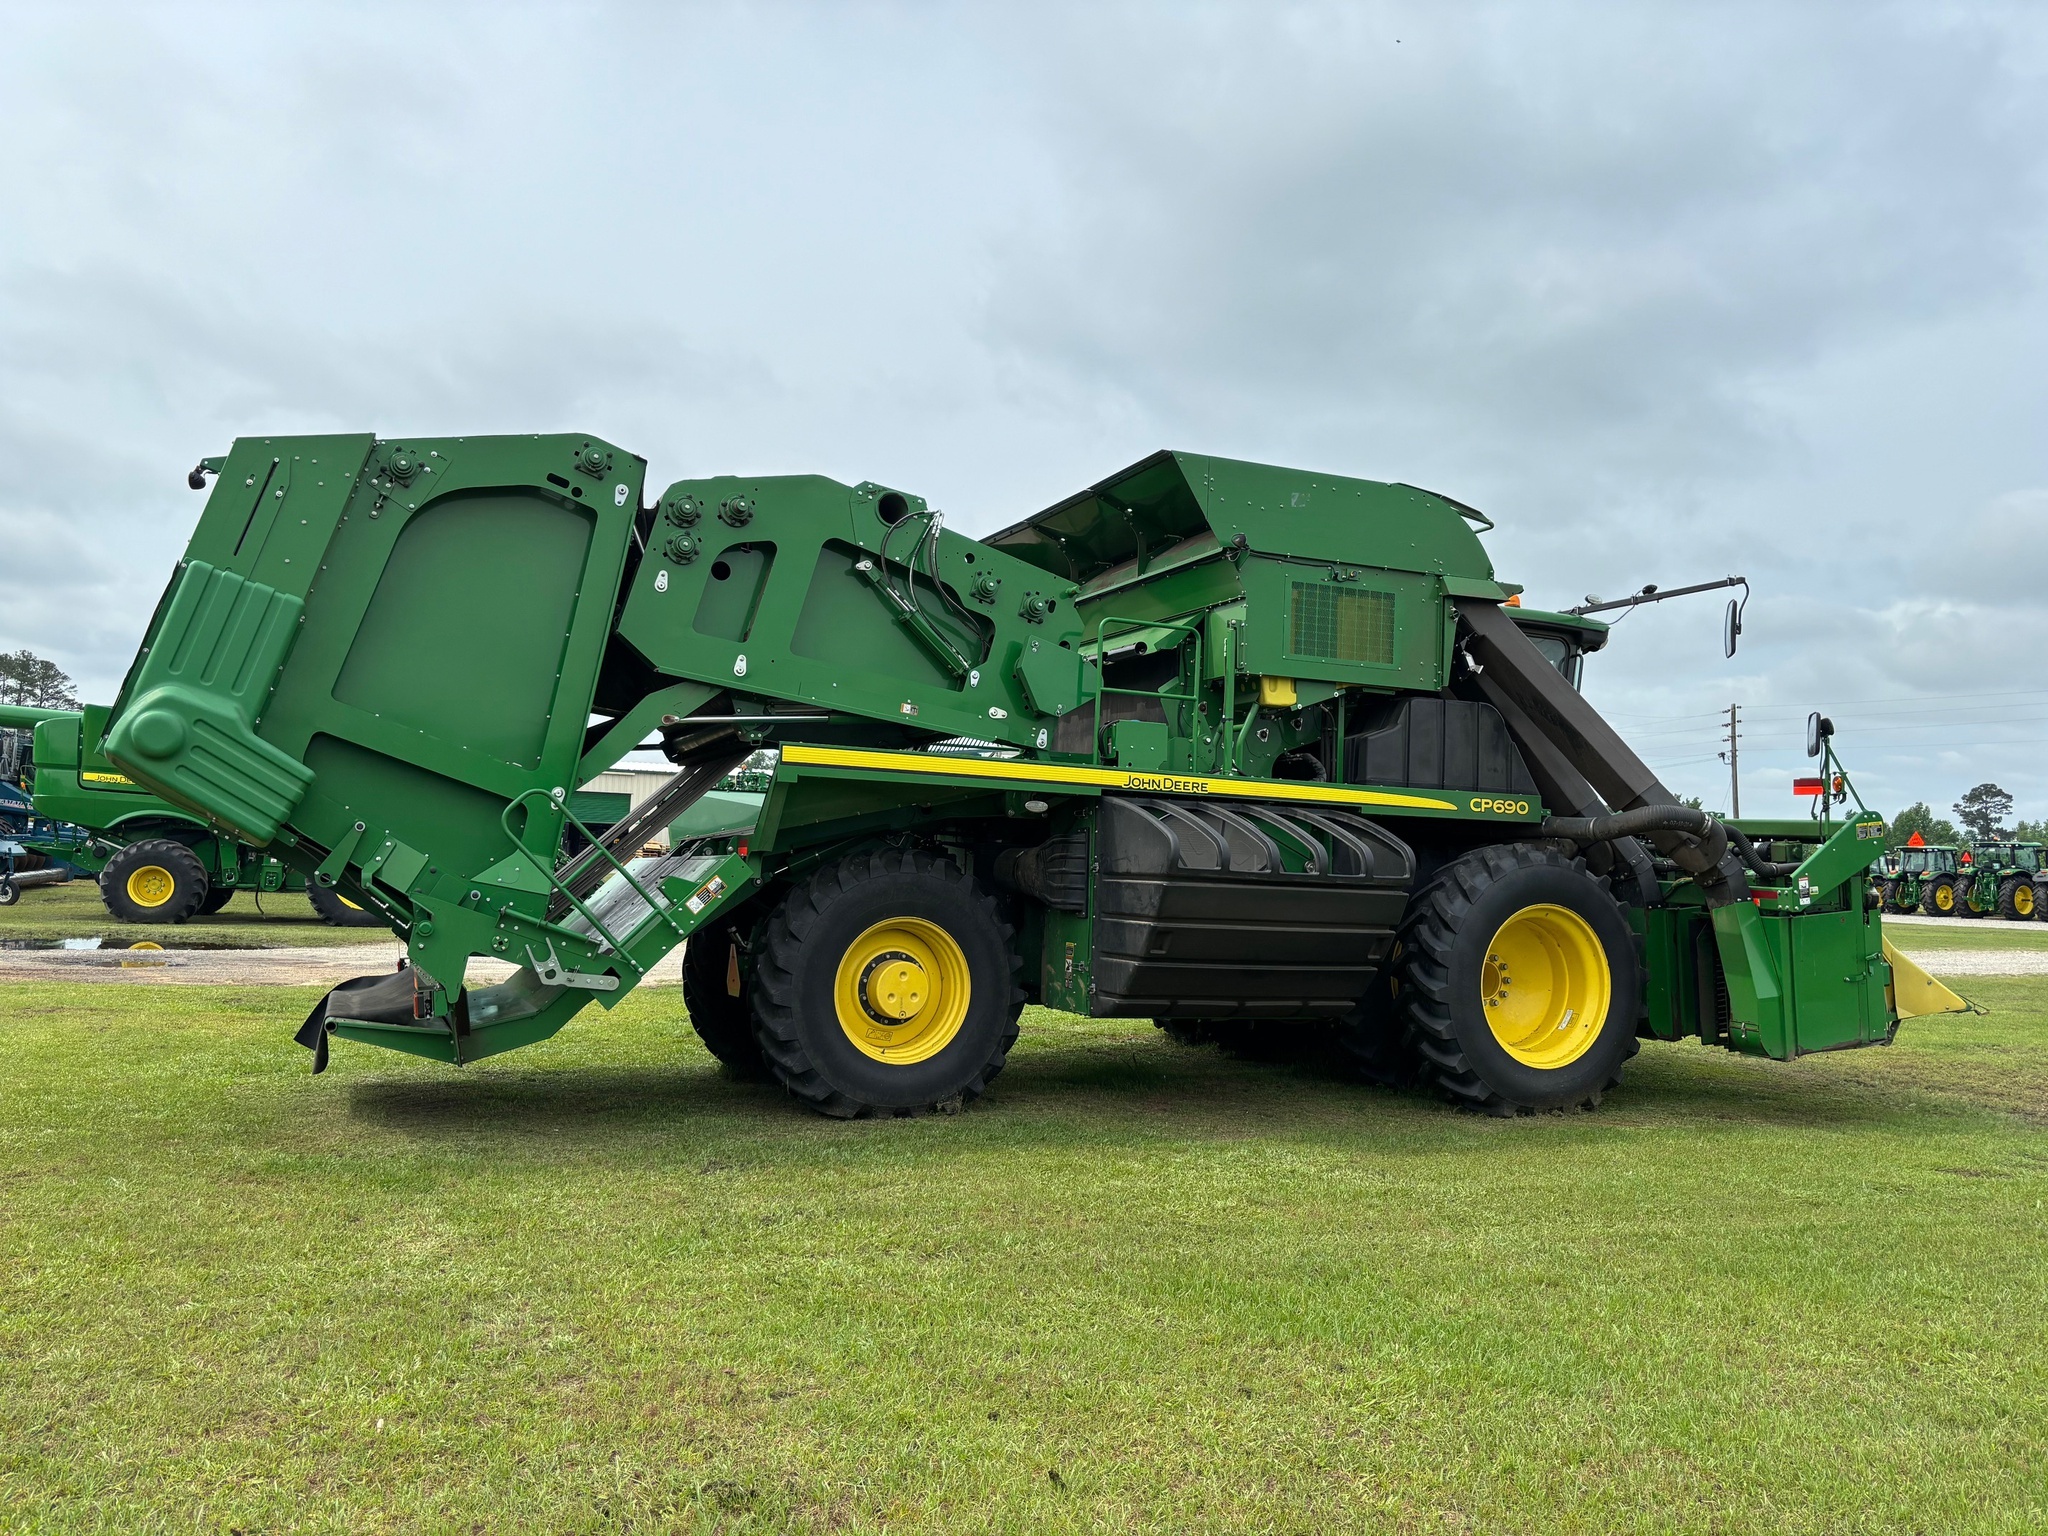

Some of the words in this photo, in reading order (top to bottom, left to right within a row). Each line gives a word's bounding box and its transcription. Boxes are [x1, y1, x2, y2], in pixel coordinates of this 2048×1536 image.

[1123, 775, 1161, 789] JOHN
[1163, 777, 1209, 793] DEERE
[1470, 798, 1529, 814] CP690
